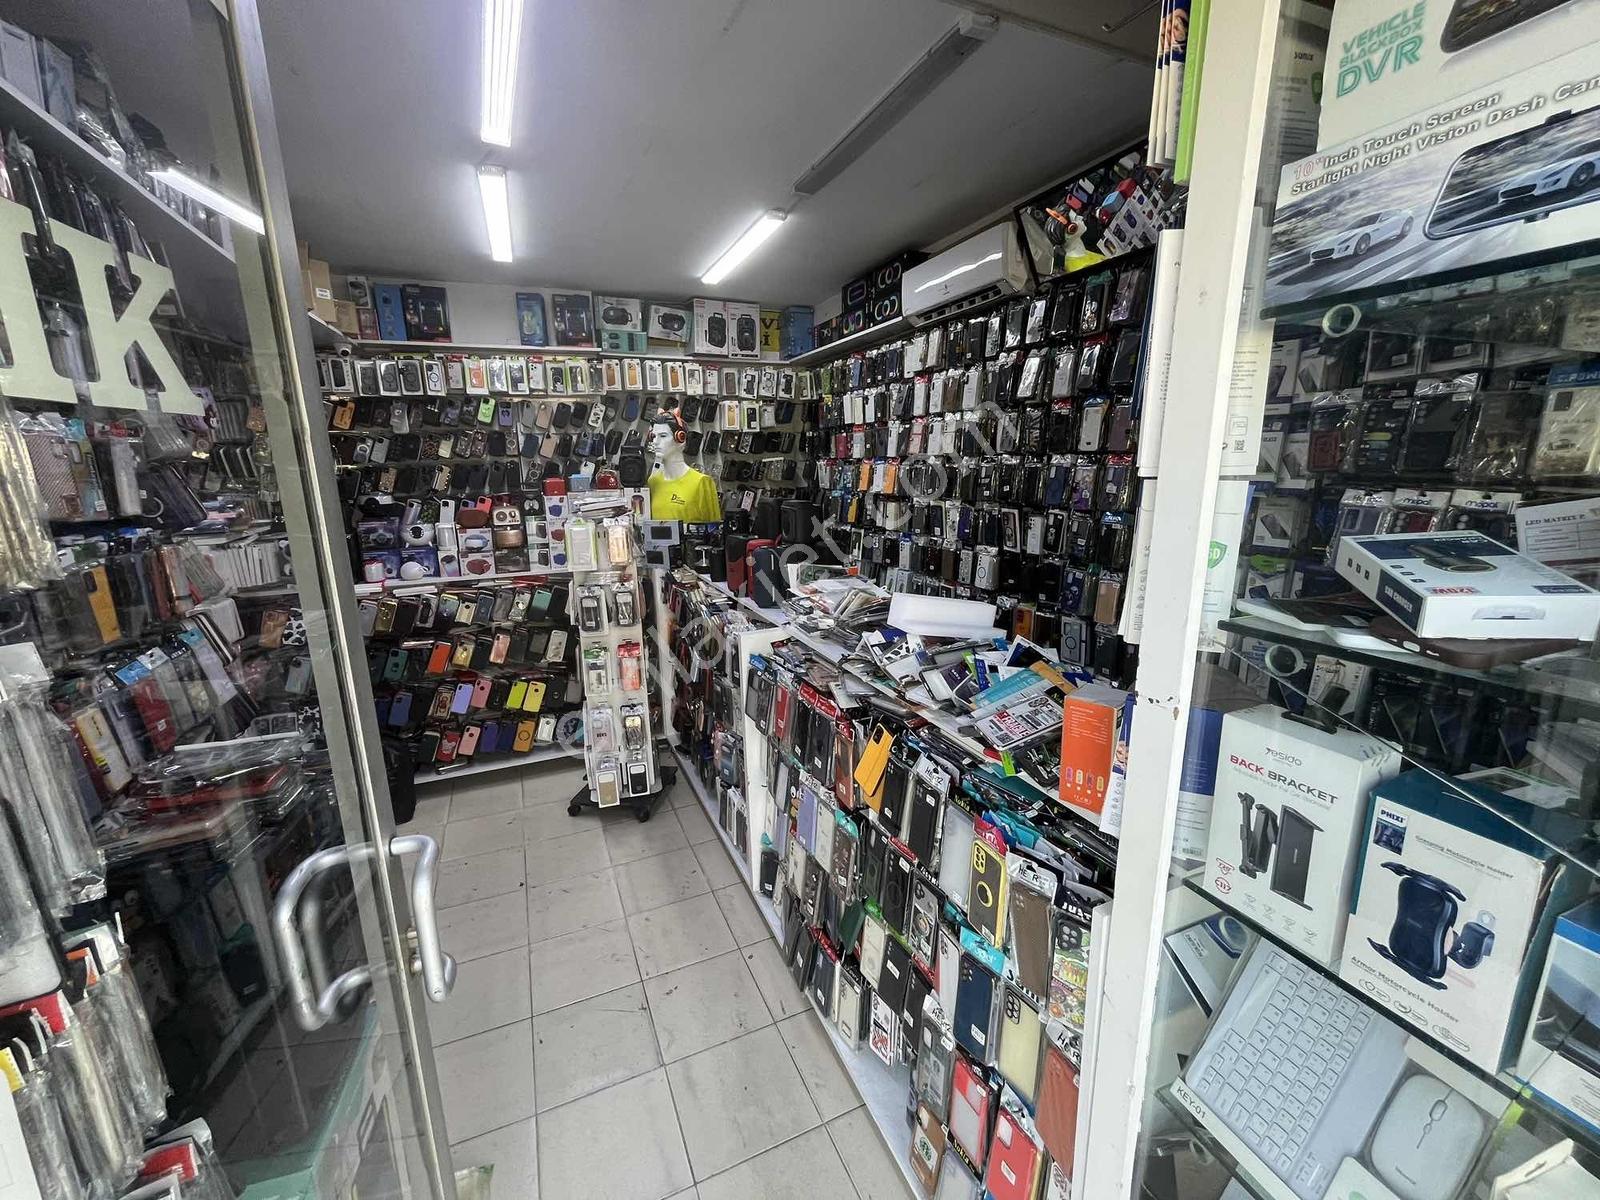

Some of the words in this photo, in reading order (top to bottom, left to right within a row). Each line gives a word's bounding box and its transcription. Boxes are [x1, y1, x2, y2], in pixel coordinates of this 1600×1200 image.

[1339, 18, 1424, 68] BLACKBOX
[1342, 1, 1426, 53] VEHICLE
[1336, 35, 1423, 98] DVR
[1291, 163, 1357, 196] Starlight
[1362, 143, 1411, 169] Night
[1417, 121, 1480, 151] Vision
[1486, 95, 1546, 127] Dash
[1324, 145, 1359, 169] Inch
[1364, 123, 1421, 154] Touch
[1426, 93, 1501, 130] Screen
[1230, 754, 1264, 776] BACK
[1267, 770, 1338, 805] BRACKET
[1351, 956, 1376, 974] Armor
[1377, 971, 1426, 1004] Motorcycle
[1427, 1001, 1460, 1023] Holder
[1177, 1086, 1206, 1119] KEY-01
